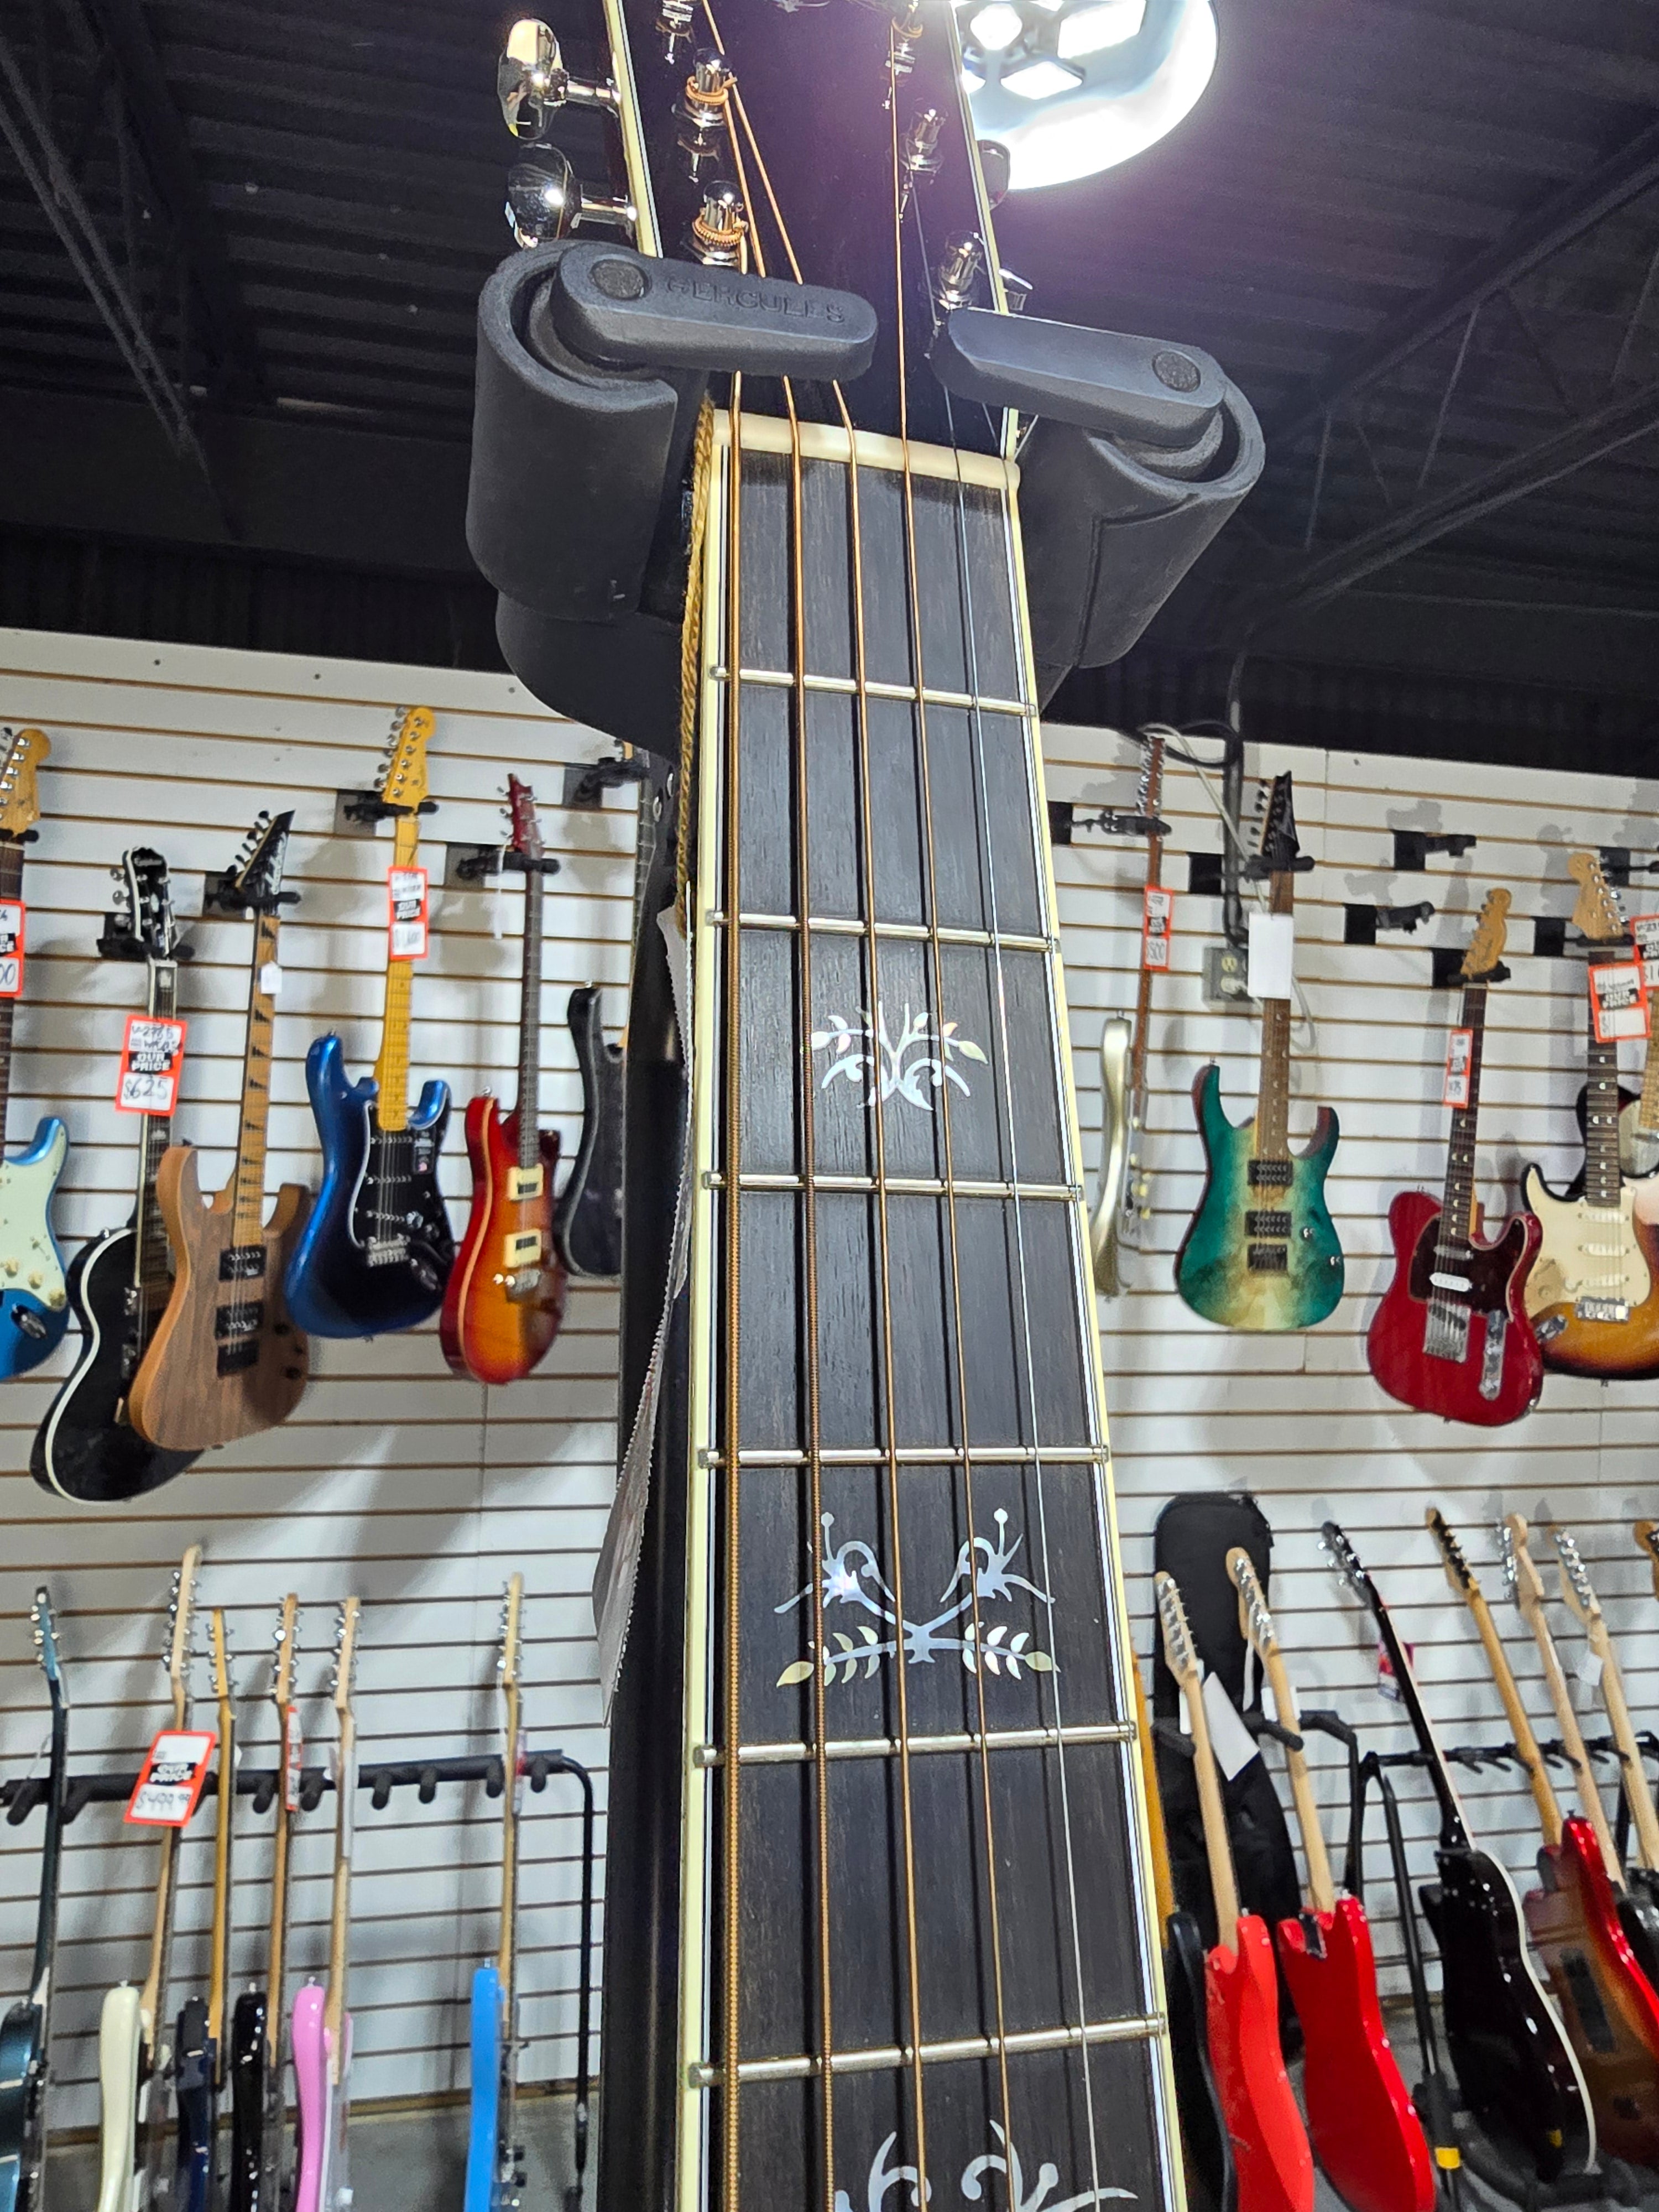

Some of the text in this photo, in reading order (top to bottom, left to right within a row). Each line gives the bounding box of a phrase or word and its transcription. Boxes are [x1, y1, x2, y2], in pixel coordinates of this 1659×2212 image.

[666, 276, 845, 324] HERCULES
[137, 1052, 165, 1062] OUR
[131, 1061, 171, 1072] PRICE
[124, 1077, 169, 1100] $625
